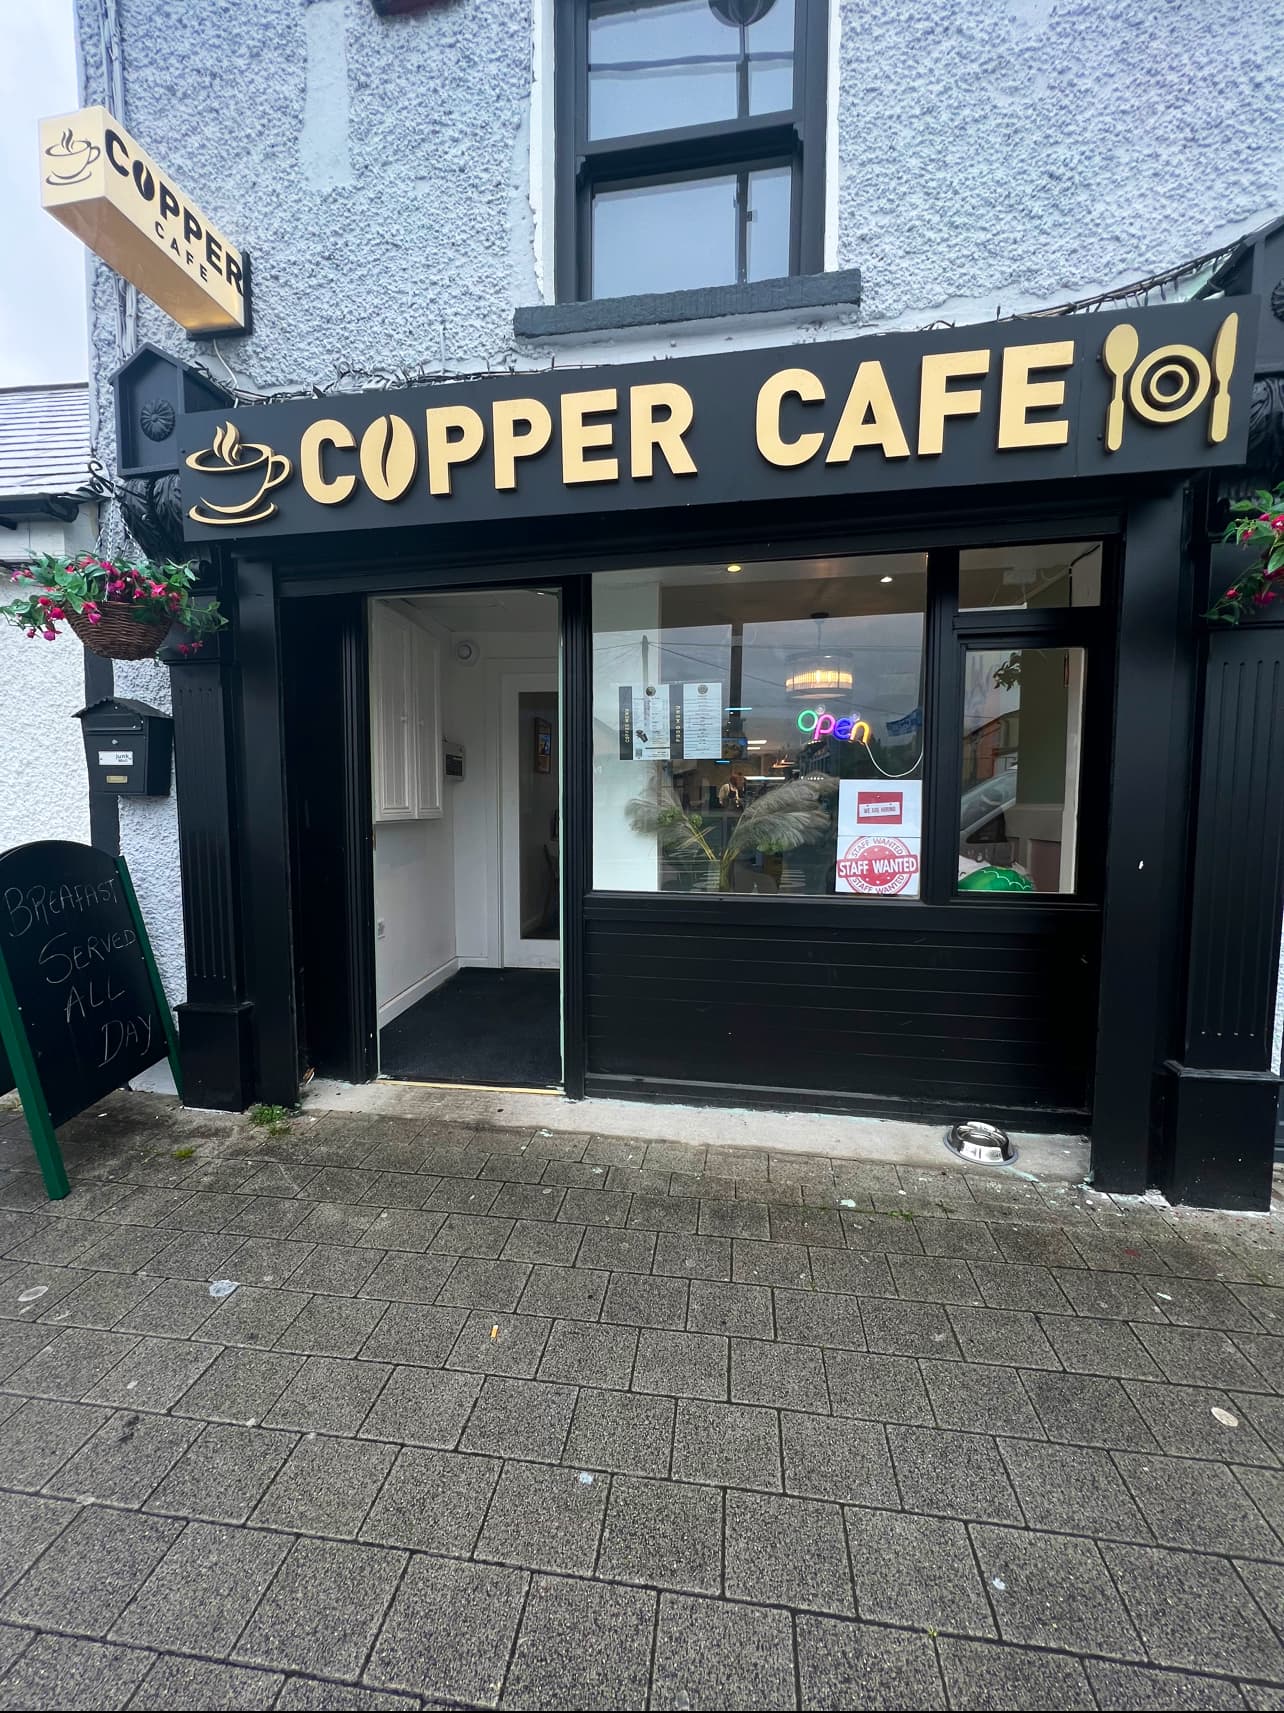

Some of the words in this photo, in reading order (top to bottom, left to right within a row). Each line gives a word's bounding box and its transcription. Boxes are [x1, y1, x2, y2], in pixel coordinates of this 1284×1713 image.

[104, 128, 243, 297] COPPER
[155, 221, 208, 282] CAFE
[300, 382, 698, 505] COPPER
[755, 340, 1075, 467] CAFE
[839, 861, 869, 876] STAFF
[872, 858, 917, 874] WANTED
[851, 839, 871, 858] STAFF
[873, 837, 904, 856] WANTED
[4, 878, 118, 937] BREAFAST
[852, 877, 873, 894] STAFF
[875, 874, 905, 894] WANTED
[38, 929, 136, 984] SERVED
[64, 976, 125, 1024] ALL
[98, 1015, 151, 1068] DAY
